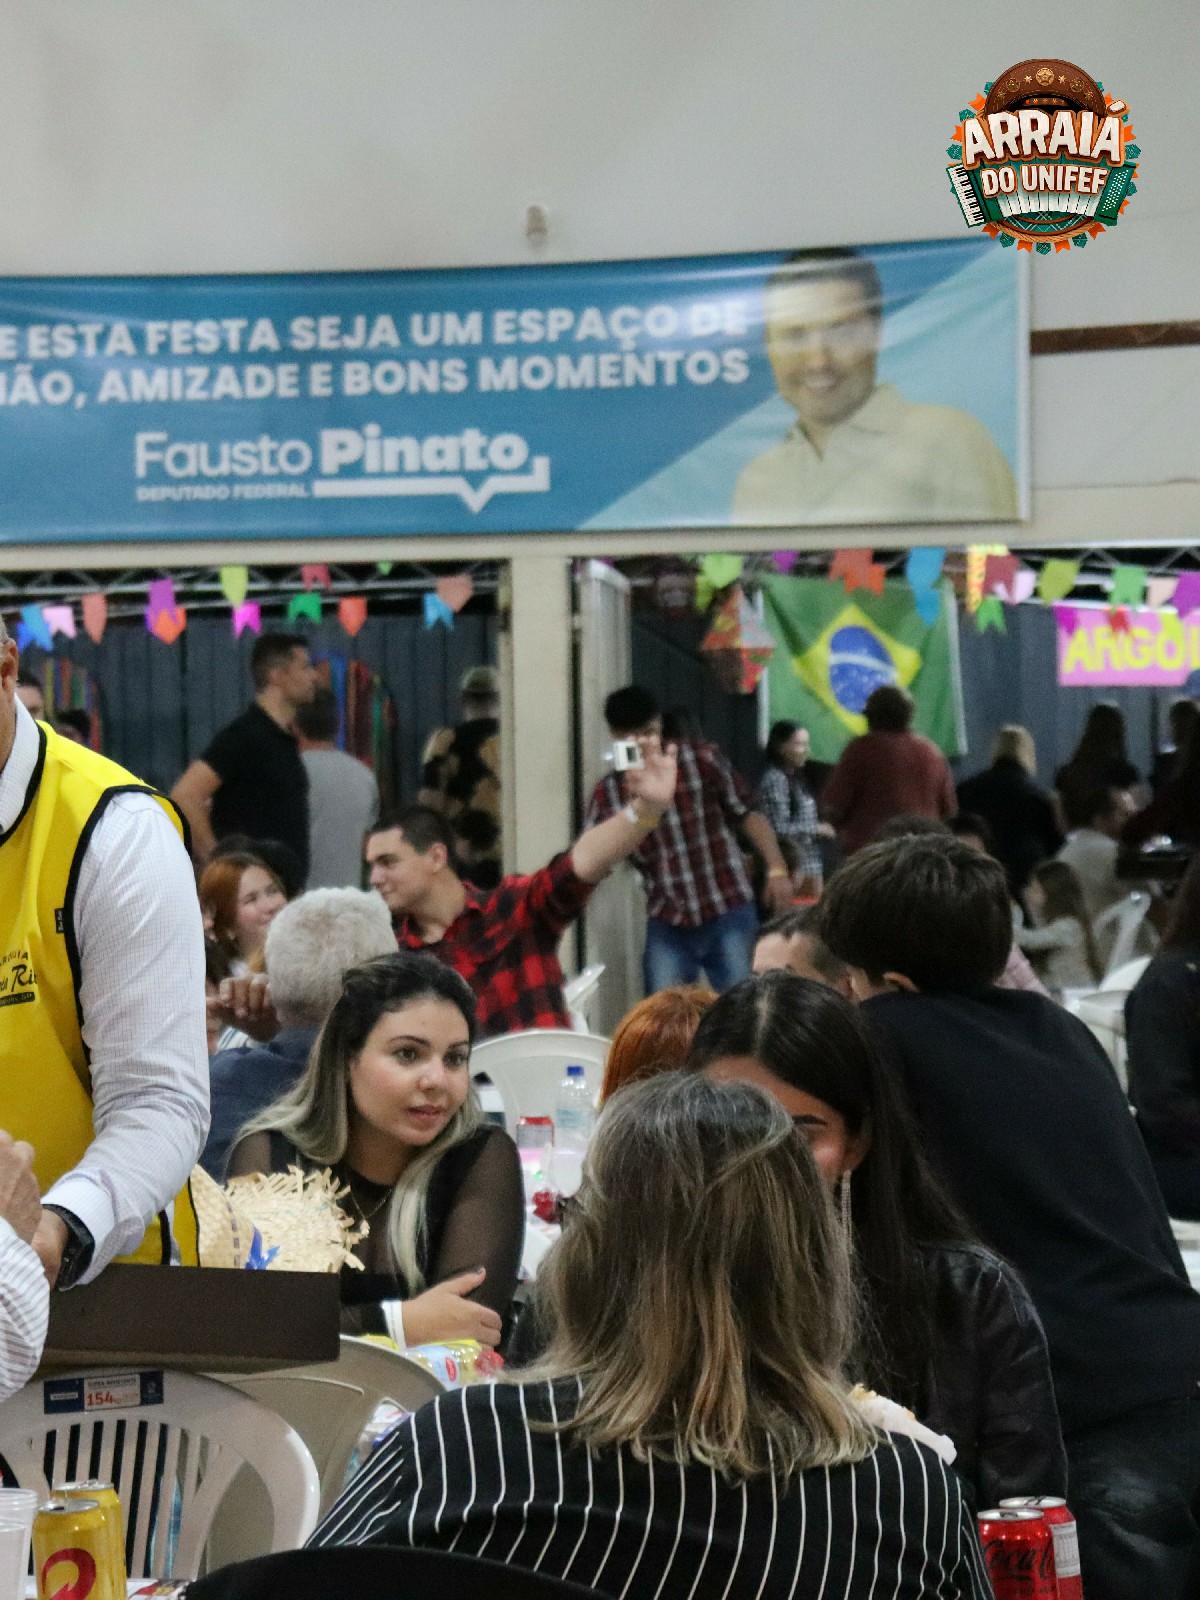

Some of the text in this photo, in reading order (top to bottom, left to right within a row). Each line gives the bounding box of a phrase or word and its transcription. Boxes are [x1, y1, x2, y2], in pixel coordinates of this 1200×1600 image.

[27, 321, 137, 360] ESTA
[146, 317, 281, 355] FESTA
[291, 313, 400, 351] SEJA
[410, 310, 483, 346] UM
[493, 304, 679, 350] ESPAÇO
[690, 301, 749, 336] DE
[98, 362, 300, 403] AMIZADE
[310, 362, 333, 397] E
[343, 359, 468, 397] BONS
[478, 347, 750, 392] MOMENTOS
[135, 423, 530, 478] Fausto Pinato
[135, 482, 308, 501] DEPUTADO FEDERAL
